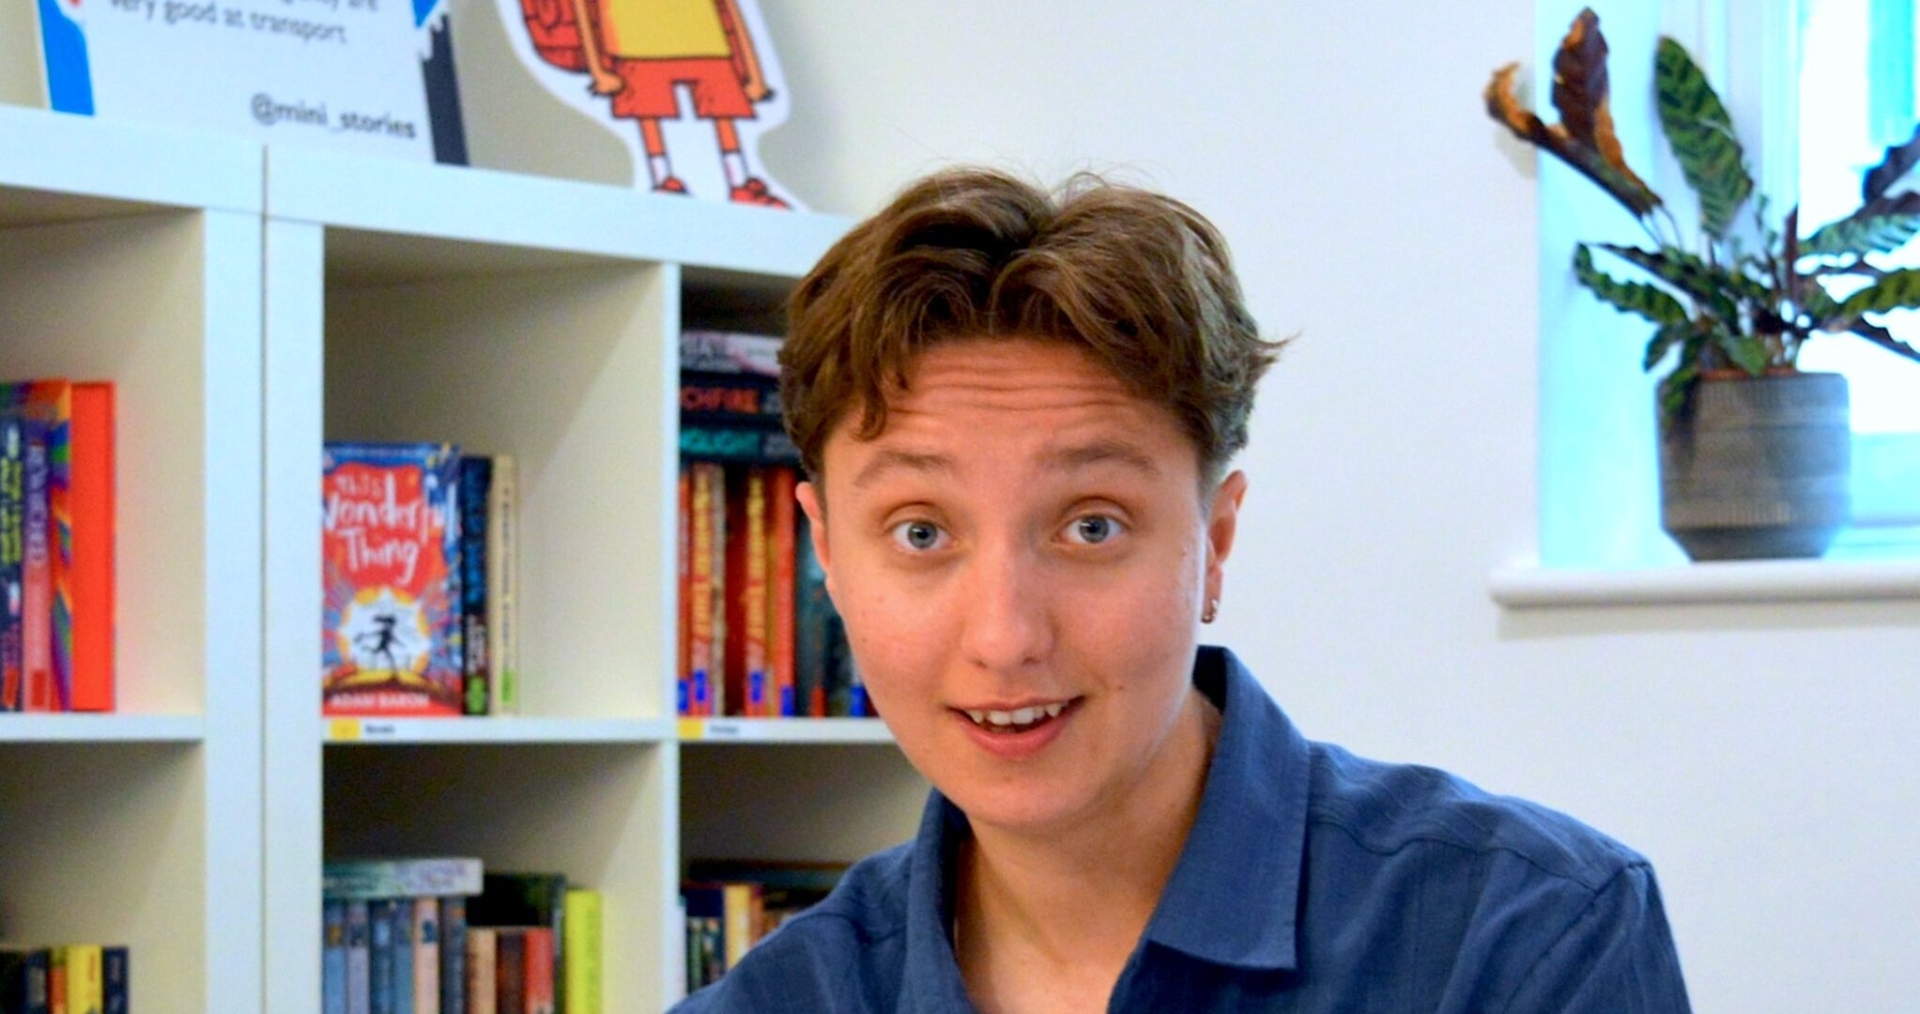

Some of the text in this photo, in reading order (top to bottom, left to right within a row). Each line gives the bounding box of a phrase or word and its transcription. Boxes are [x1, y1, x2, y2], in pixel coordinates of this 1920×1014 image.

[163, 1, 216, 25] good
[223, 8, 244, 27] at
[250, 11, 346, 43] transport
[251, 93, 416, 139] @mini_stories
[334, 473, 384, 498] This
[338, 527, 419, 586] Thing
